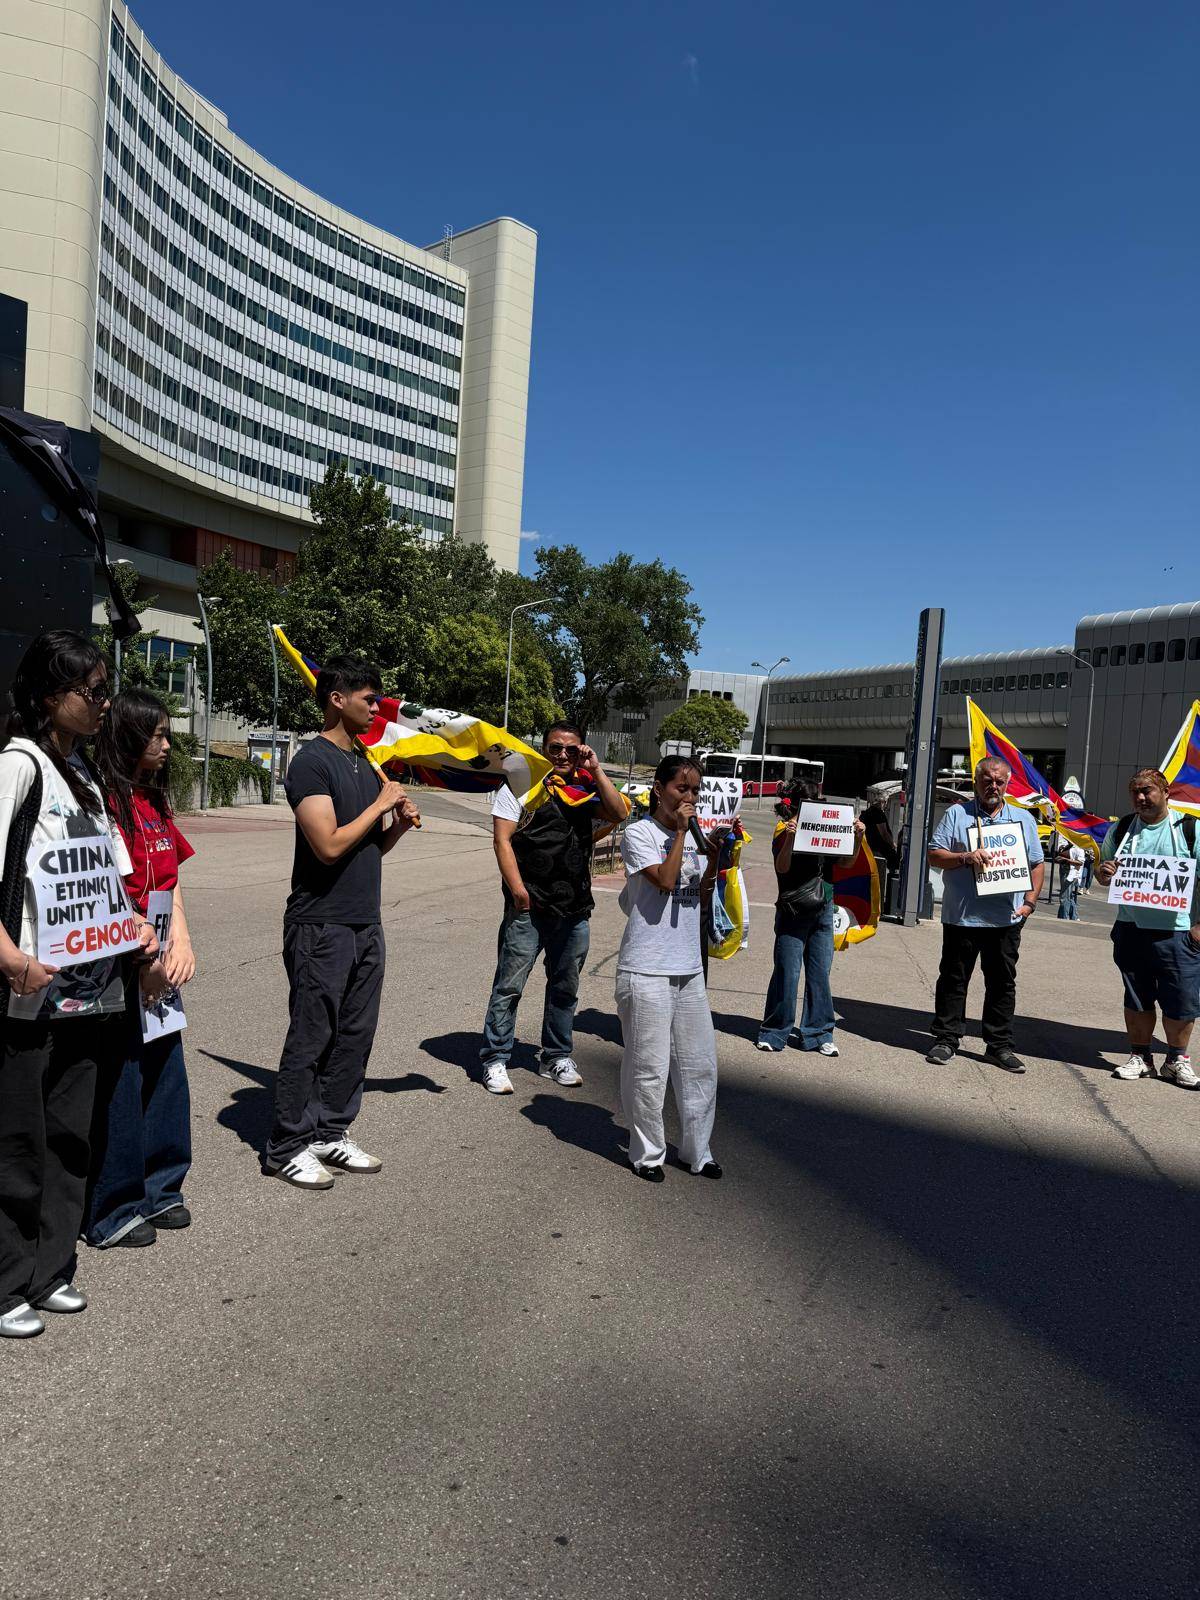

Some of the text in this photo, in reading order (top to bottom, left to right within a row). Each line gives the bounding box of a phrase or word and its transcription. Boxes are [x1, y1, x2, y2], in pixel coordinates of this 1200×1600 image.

[711, 795, 739, 815] LAW
[822, 809, 840, 819] KEINE
[811, 837, 841, 848] IN TIBET
[39, 844, 114, 875] CHINA
[977, 868, 1028, 883] JUSTICE
[1153, 873, 1190, 894] LAW
[106, 873, 128, 915] LA
[682, 888, 701, 896] TIBE
